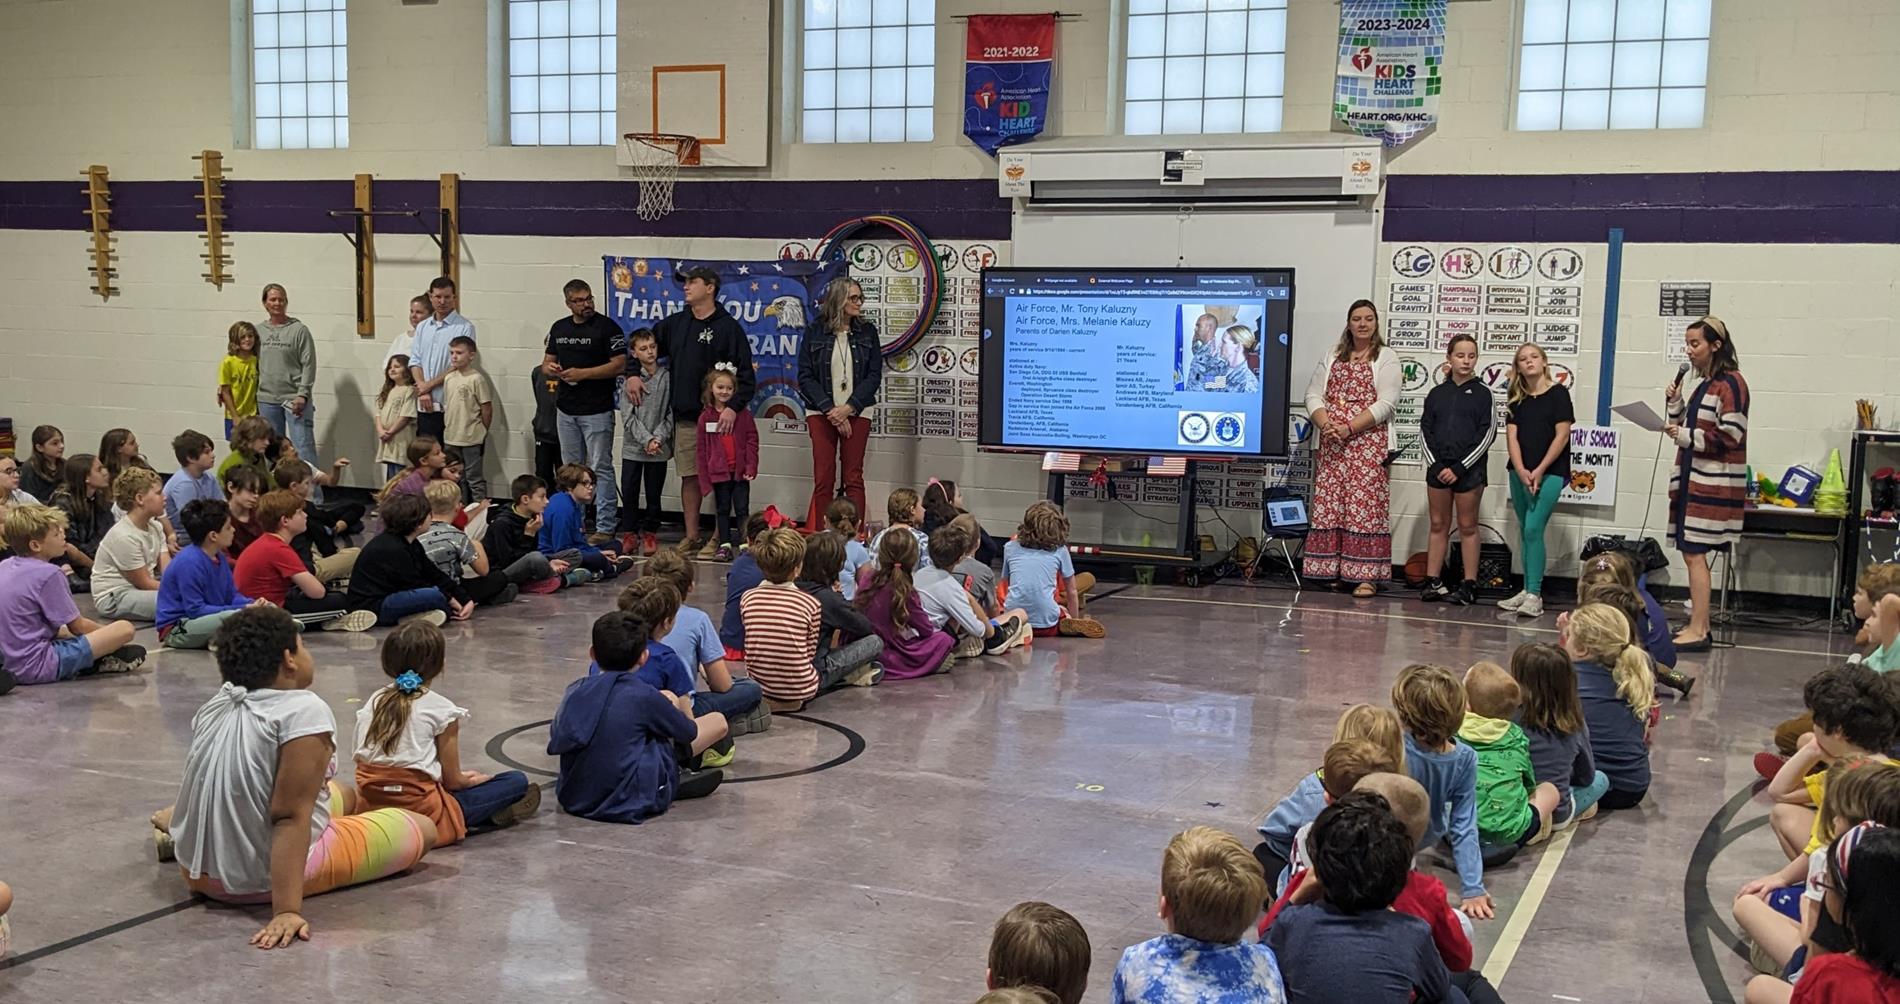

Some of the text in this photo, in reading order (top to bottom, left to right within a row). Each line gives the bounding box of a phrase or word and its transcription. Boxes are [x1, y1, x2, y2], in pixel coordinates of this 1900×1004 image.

[1358, 19, 1430, 31] 2023-2024
[984, 47, 1039, 57] 2021-2022
[1376, 64, 1416, 78] KIDS
[1374, 79, 1415, 89] HEART
[1000, 116, 1037, 129] HEART
[1347, 112, 1427, 122] HEART.ORG/KHC
[854, 247, 864, 263] C
[904, 249, 916, 268] D
[982, 253, 992, 267] F
[1413, 255, 1430, 272] G
[1446, 255, 1461, 272] H
[1496, 255, 1502, 272] I
[1562, 256, 1576, 275] J
[615, 292, 684, 320] THAN
[1016, 304, 1137, 316] Air Force, Mr. Tony Kaluzny
[1016, 316, 1151, 327] Air Force, Mrs. Melanie Kaluzy
[926, 350, 938, 366] O
[1488, 368, 1501, 386] Y
[1295, 422, 1310, 440] V
[1571, 429, 1617, 448] TARY SCHOOL
[1570, 452, 1614, 466] THE MONTH
